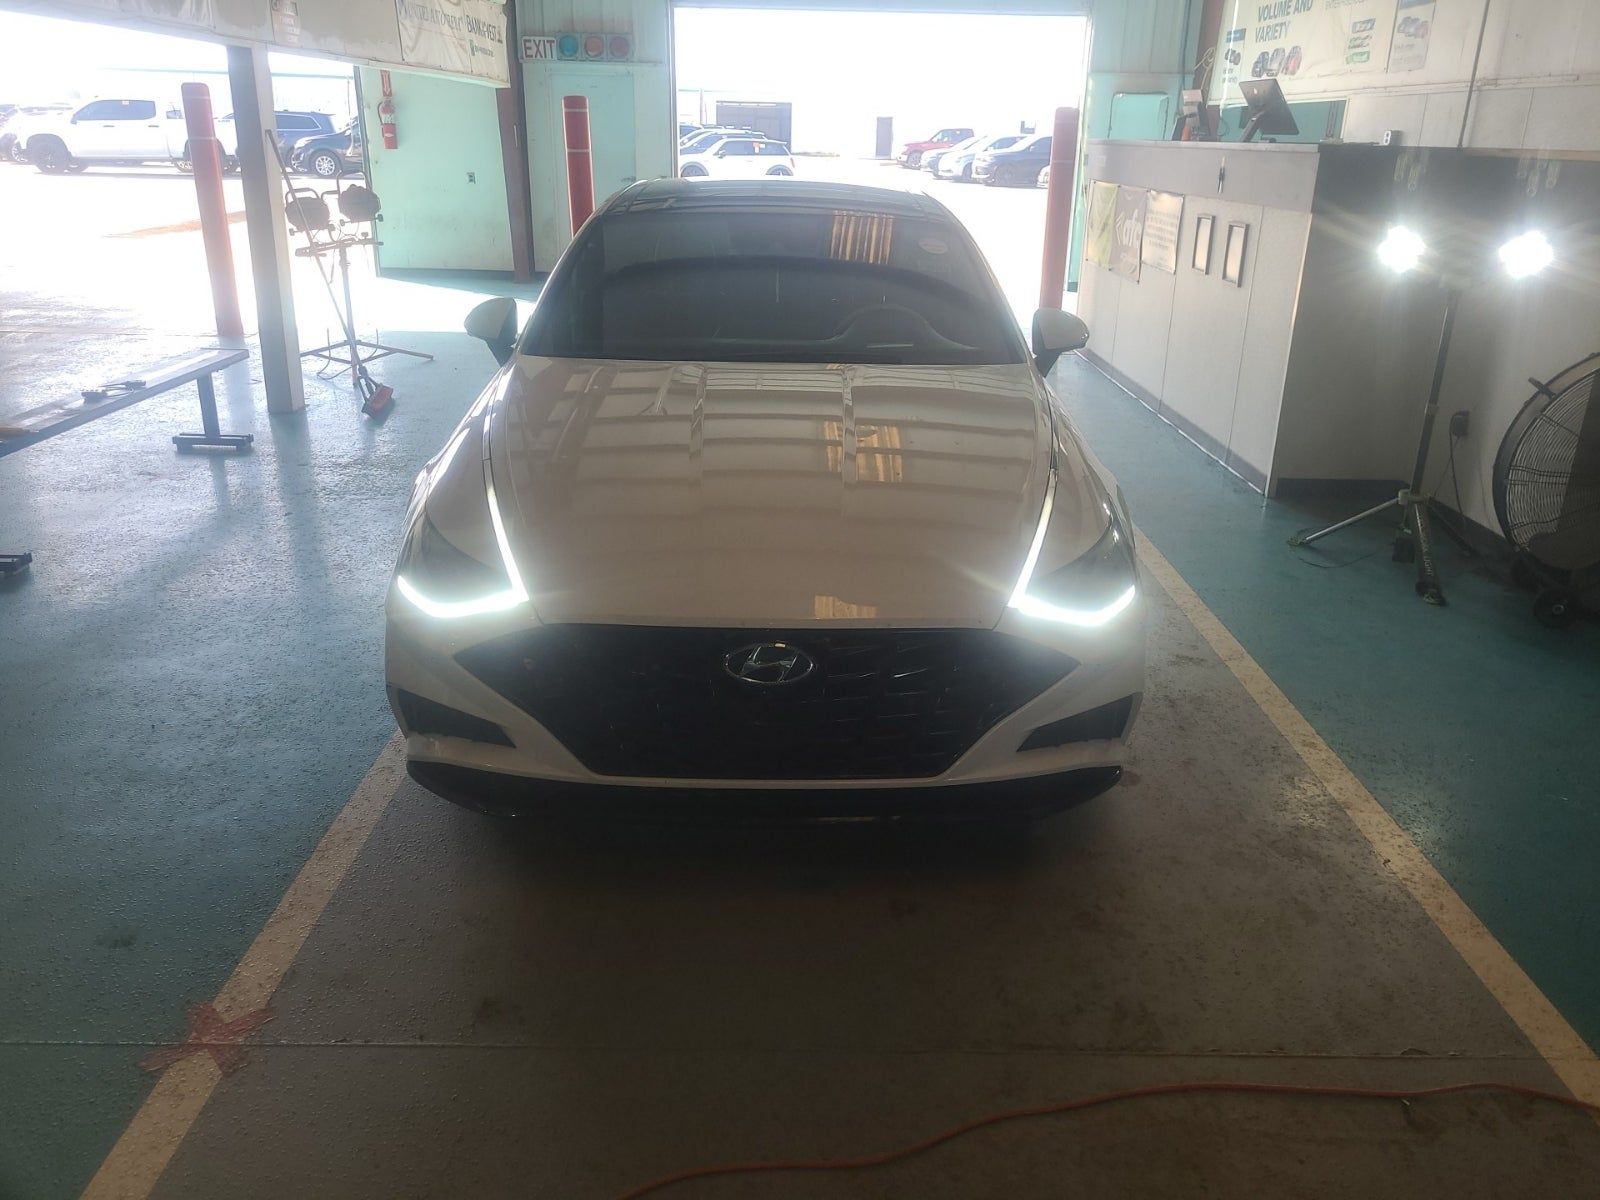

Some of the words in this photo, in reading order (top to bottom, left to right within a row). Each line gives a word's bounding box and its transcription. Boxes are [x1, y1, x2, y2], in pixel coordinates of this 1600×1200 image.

[1257, 0, 1291, 22] VOLUME
[1293, 0, 1313, 15] AND
[1255, 21, 1290, 43] VARIETY
[523, 39, 555, 59] EXIT
